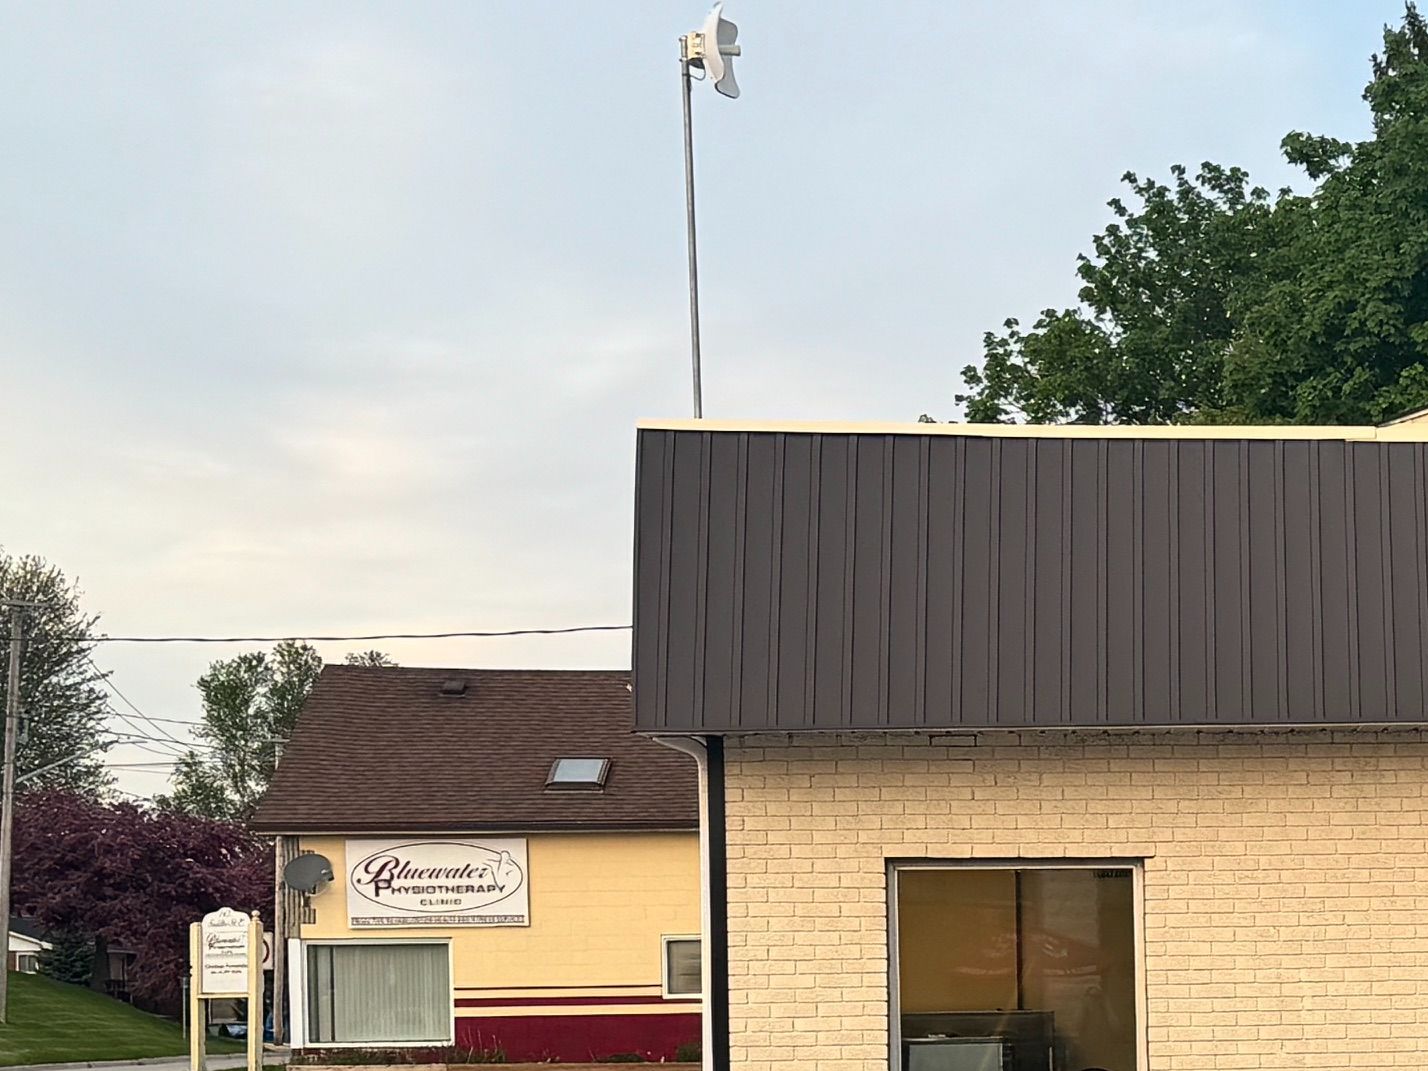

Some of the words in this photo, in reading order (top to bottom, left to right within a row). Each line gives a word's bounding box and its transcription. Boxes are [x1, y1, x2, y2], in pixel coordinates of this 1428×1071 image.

[356, 855, 489, 885] Bluewater
[374, 879, 506, 897] PHYSIOTHERAPY
[420, 898, 462, 906] CLINIC
